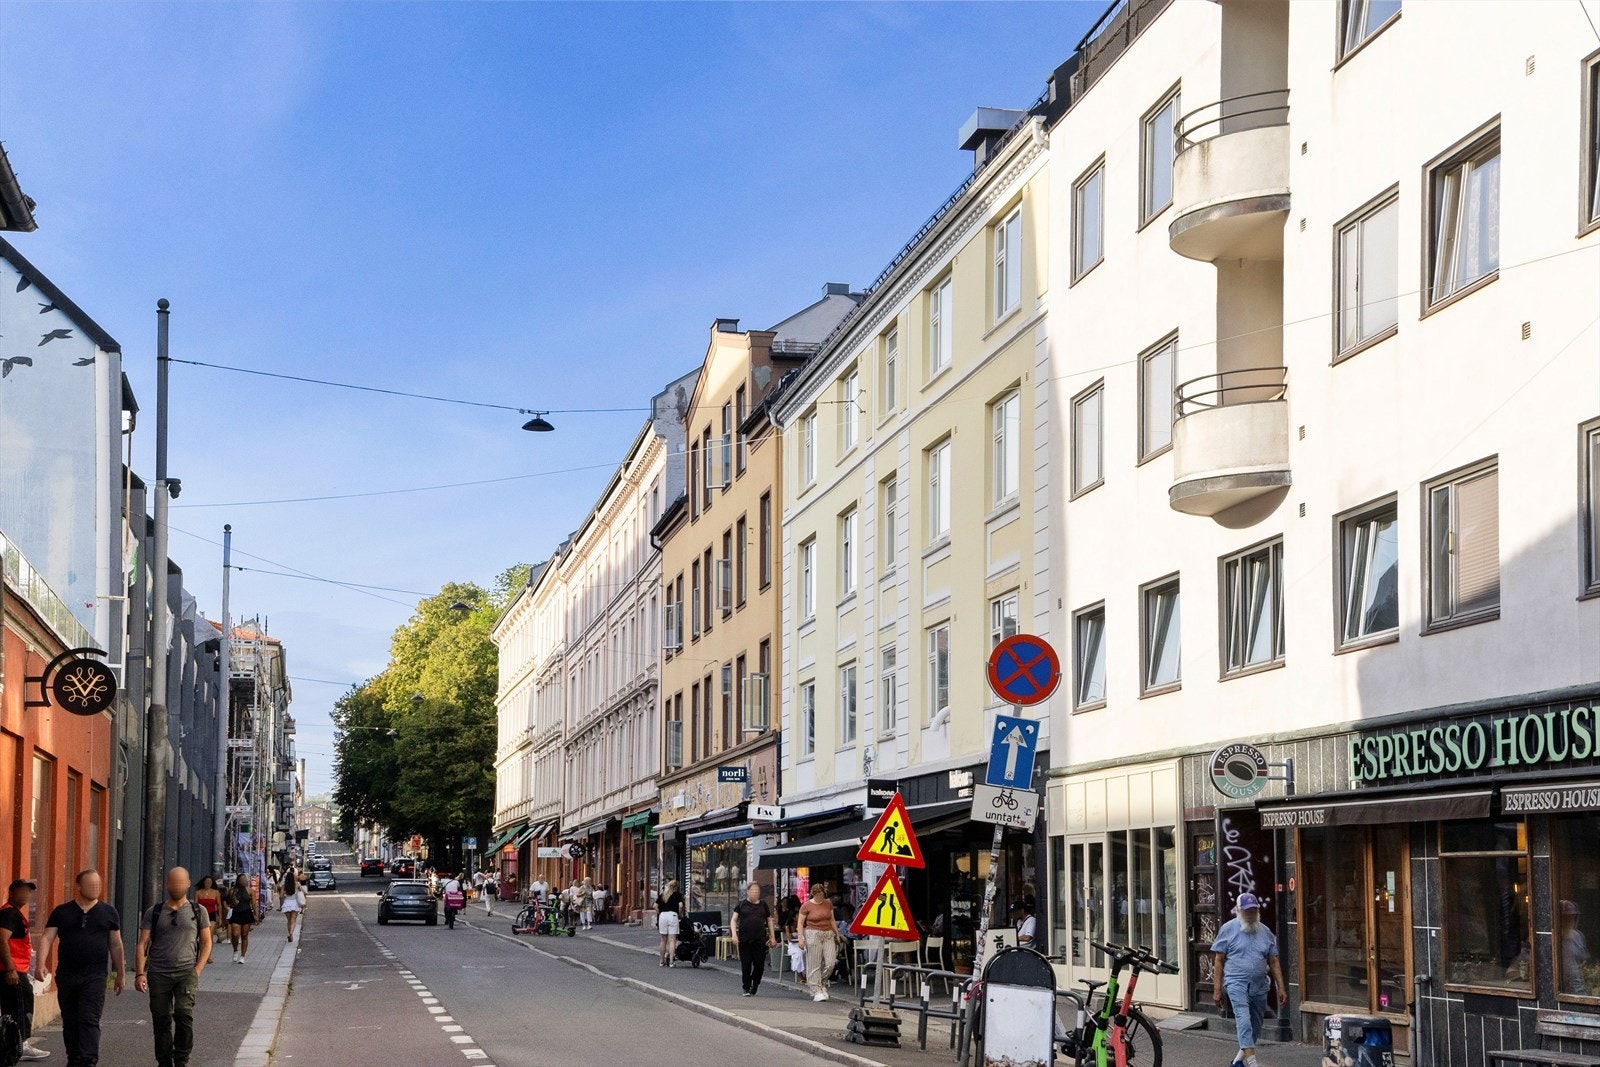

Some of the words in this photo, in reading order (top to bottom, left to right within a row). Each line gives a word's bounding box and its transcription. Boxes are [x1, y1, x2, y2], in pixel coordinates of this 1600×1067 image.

[1218, 745, 1264, 764] ESPRESSO
[1349, 722, 1486, 781] ESPRESSO
[722, 769, 744, 777] norli
[1223, 782, 1260, 796] HOUSE
[1505, 792, 1560, 811] ESPRESSO
[1263, 811, 1297, 827] ESPRESSO
[1298, 809, 1324, 825] HOUSE
[993, 935, 1004, 953] ak
